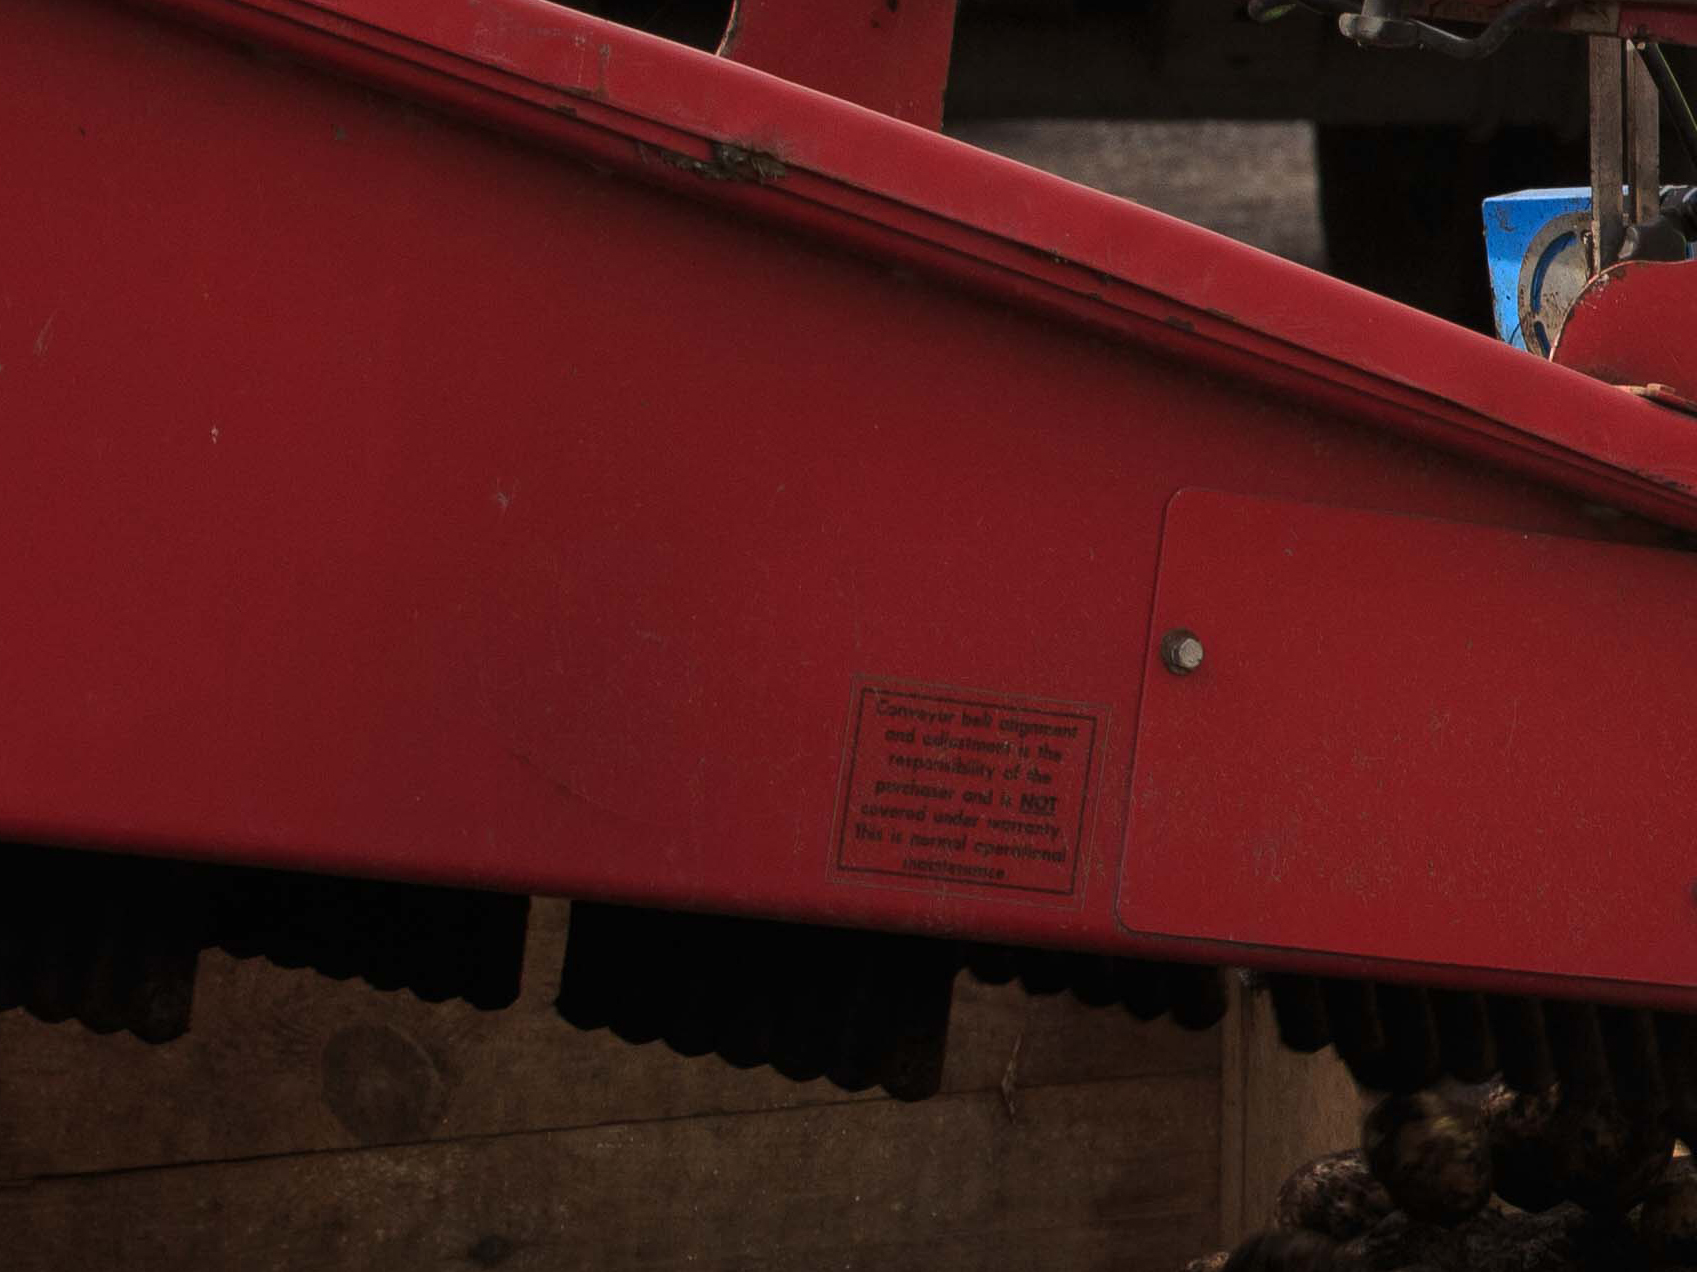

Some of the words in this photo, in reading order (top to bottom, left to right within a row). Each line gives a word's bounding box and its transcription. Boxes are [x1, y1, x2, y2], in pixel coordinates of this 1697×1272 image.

[876, 700, 956, 724] Conveyor
[961, 712, 993, 729] belt
[999, 717, 1079, 739] alignment
[885, 729, 915, 743] and
[923, 733, 1010, 754] adjustment
[1018, 745, 1030, 758] is
[1038, 743, 1062, 762] the
[889, 754, 994, 779] responsibility
[1003, 766, 1020, 781] of
[1026, 768, 1052, 784] the
[875, 781, 954, 800] purchaser
[962, 790, 993, 805] and
[1001, 793, 1012, 808] is
[1020, 794, 1057, 813] NOT
[861, 803, 926, 821] covered
[933, 811, 979, 828] under
[854, 824, 883, 840] This
[889, 831, 902, 845] is
[909, 834, 967, 852] normal
[974, 840, 1067, 863] operational
